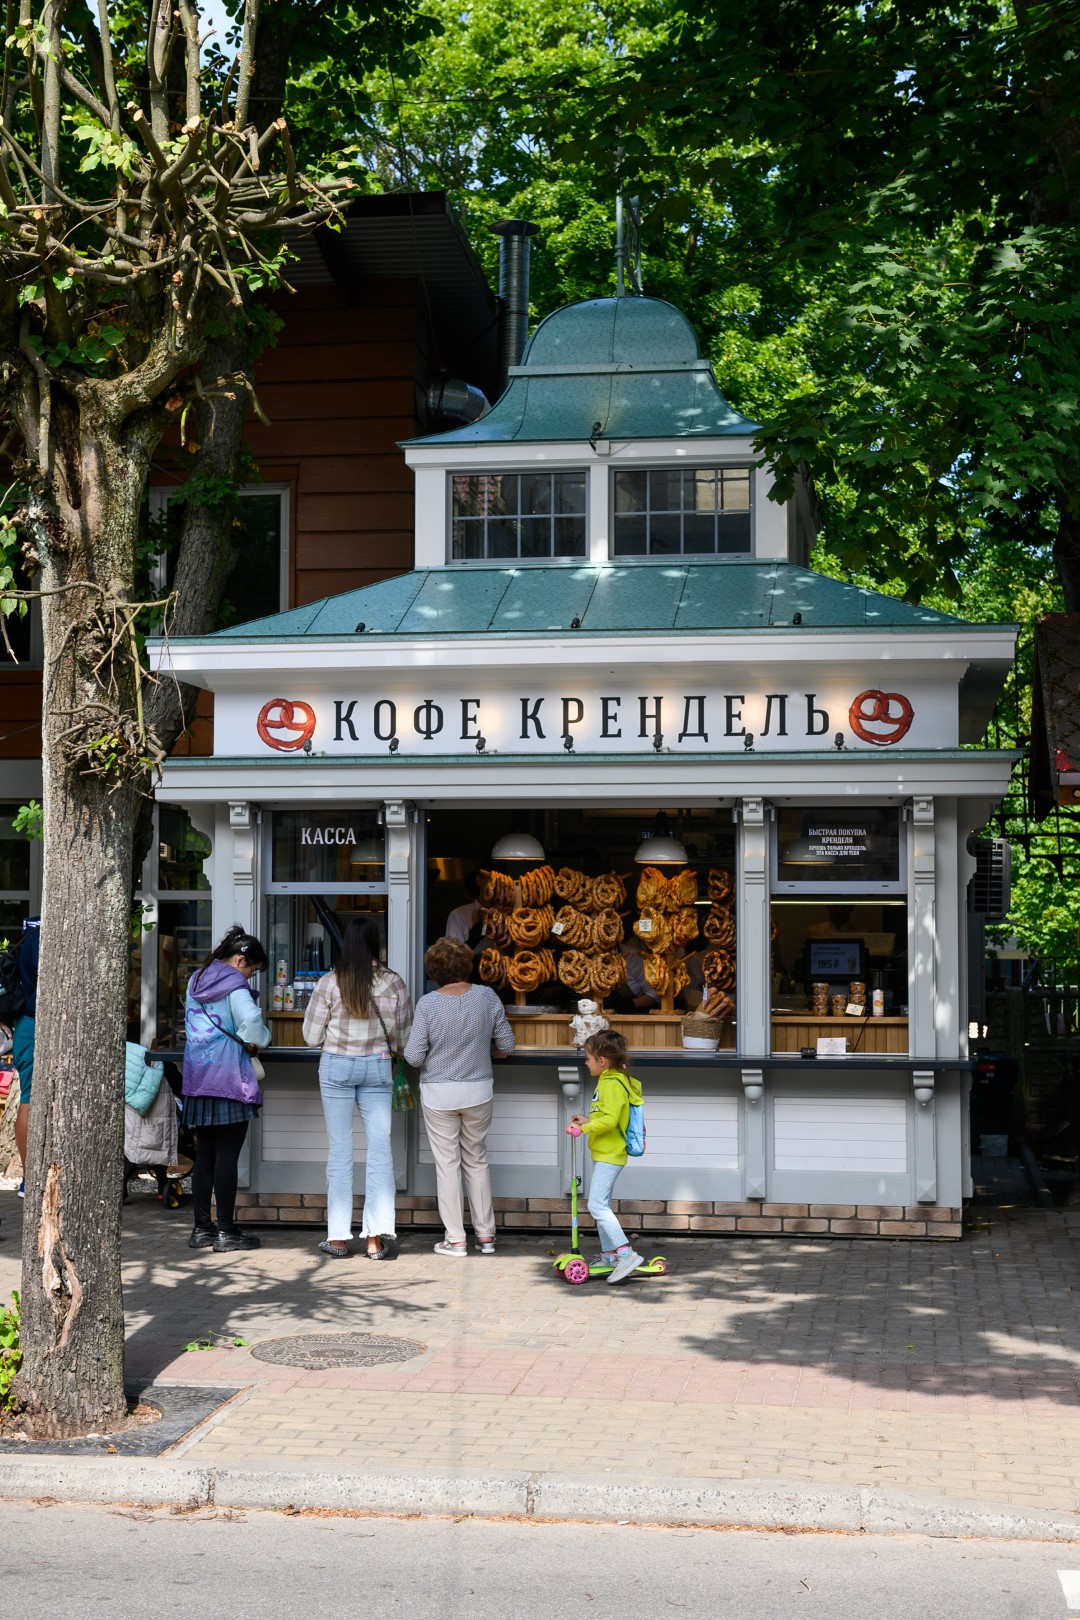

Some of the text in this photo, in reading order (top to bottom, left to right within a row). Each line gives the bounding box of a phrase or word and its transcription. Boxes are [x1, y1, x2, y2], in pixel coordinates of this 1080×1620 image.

[333, 693, 831, 743] КОФЕ КРЕНДЕЛЬ
[301, 827, 357, 844] КАССА
[818, 960, 832, 968] 185
